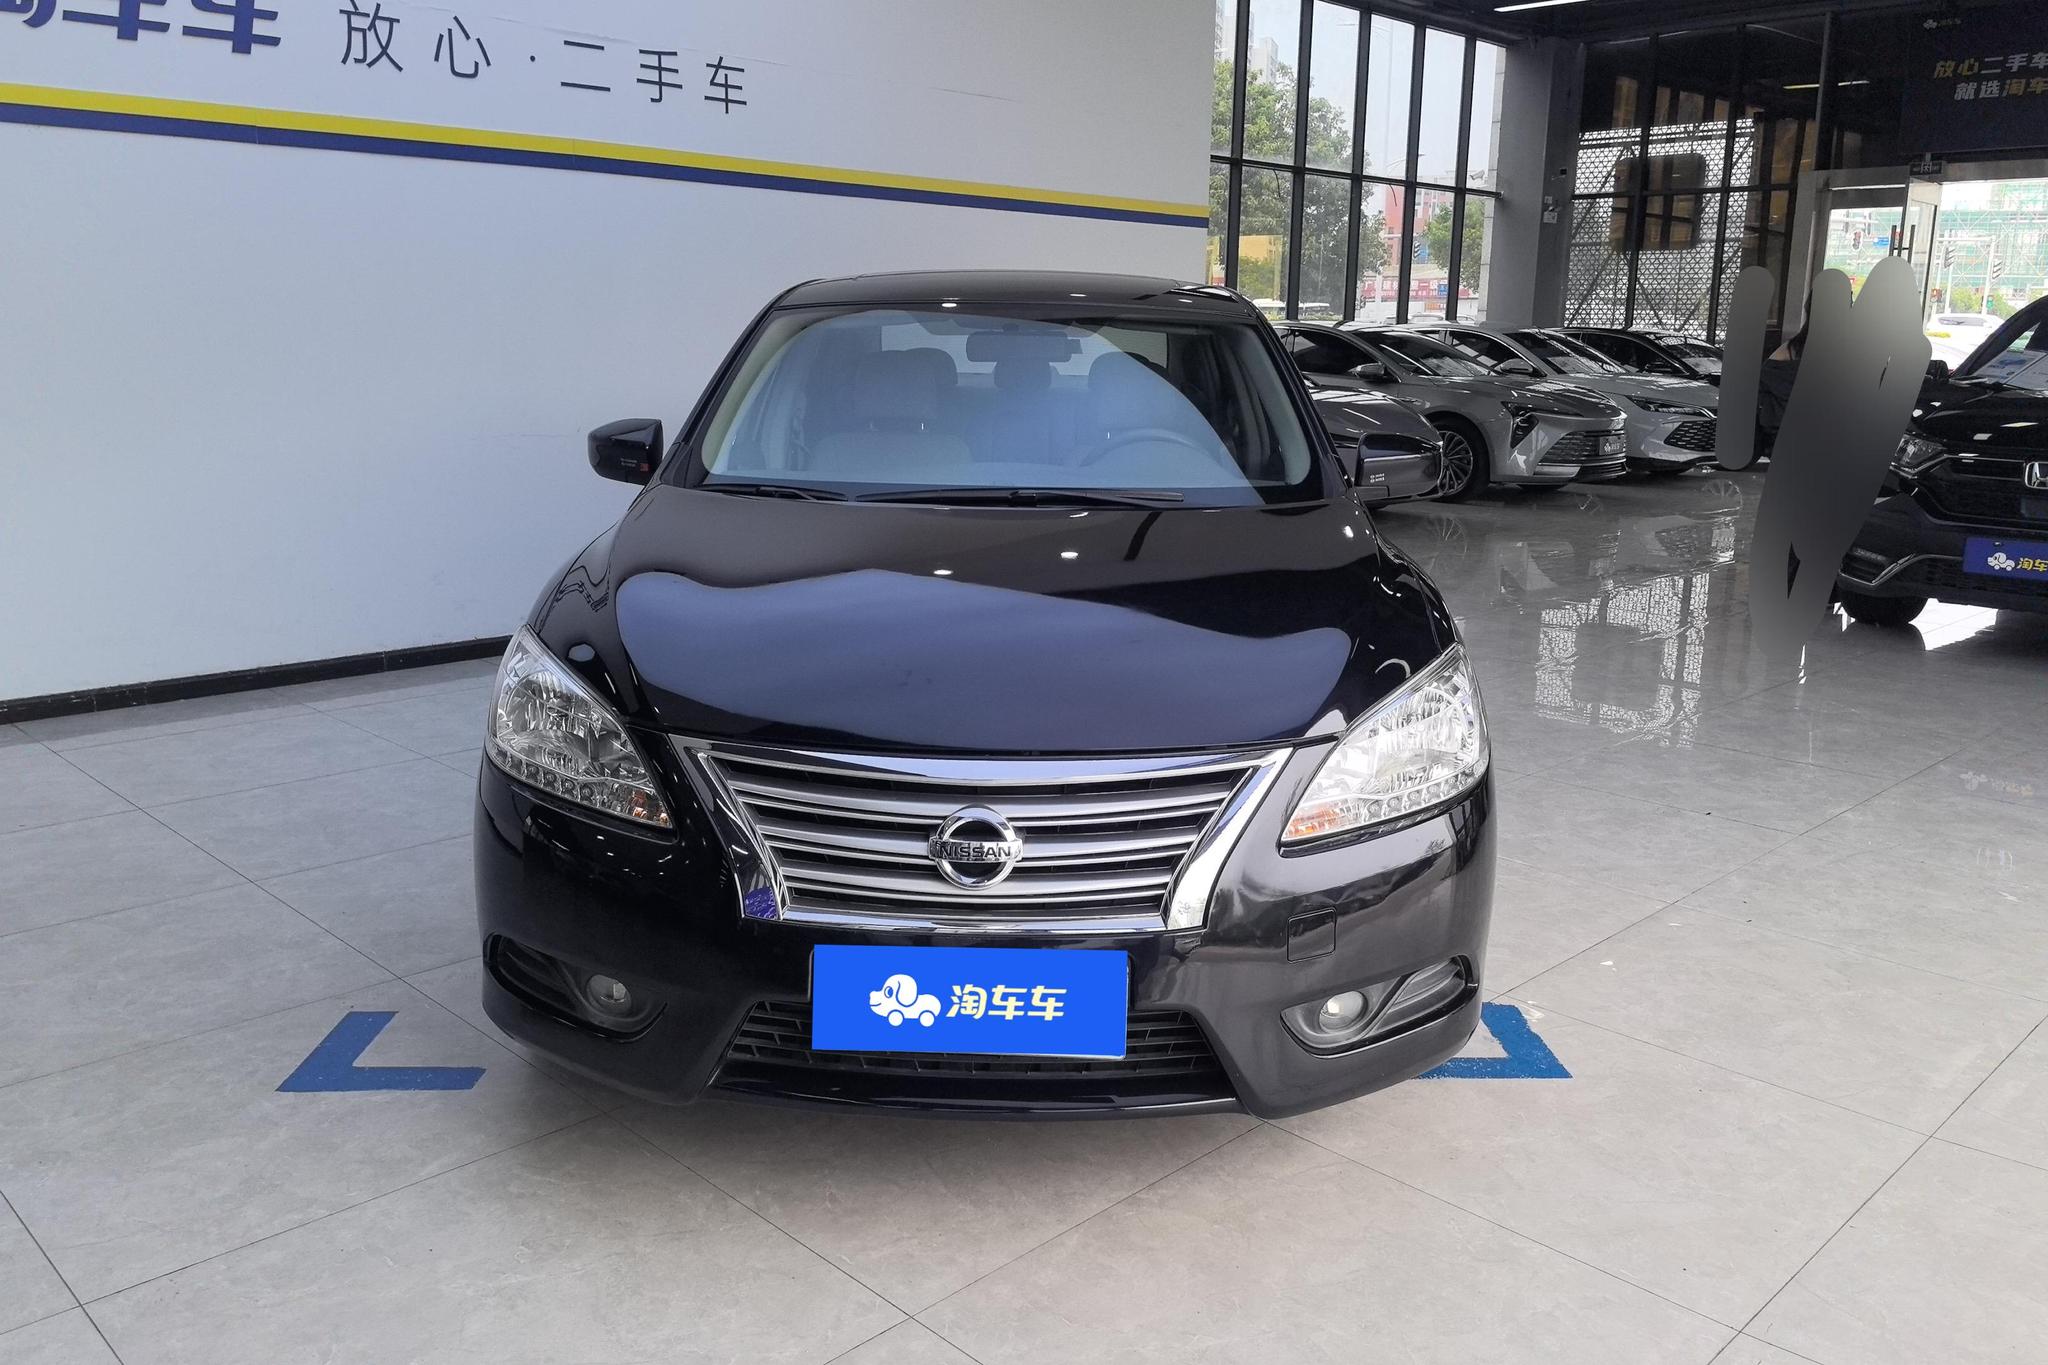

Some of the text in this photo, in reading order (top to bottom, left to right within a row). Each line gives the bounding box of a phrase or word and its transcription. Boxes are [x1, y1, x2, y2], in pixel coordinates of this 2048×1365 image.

[1934, 52, 2048, 78] 放心二手车
[939, 845, 1012, 858] NISSAN
[946, 984, 1067, 1021] 淘车车
